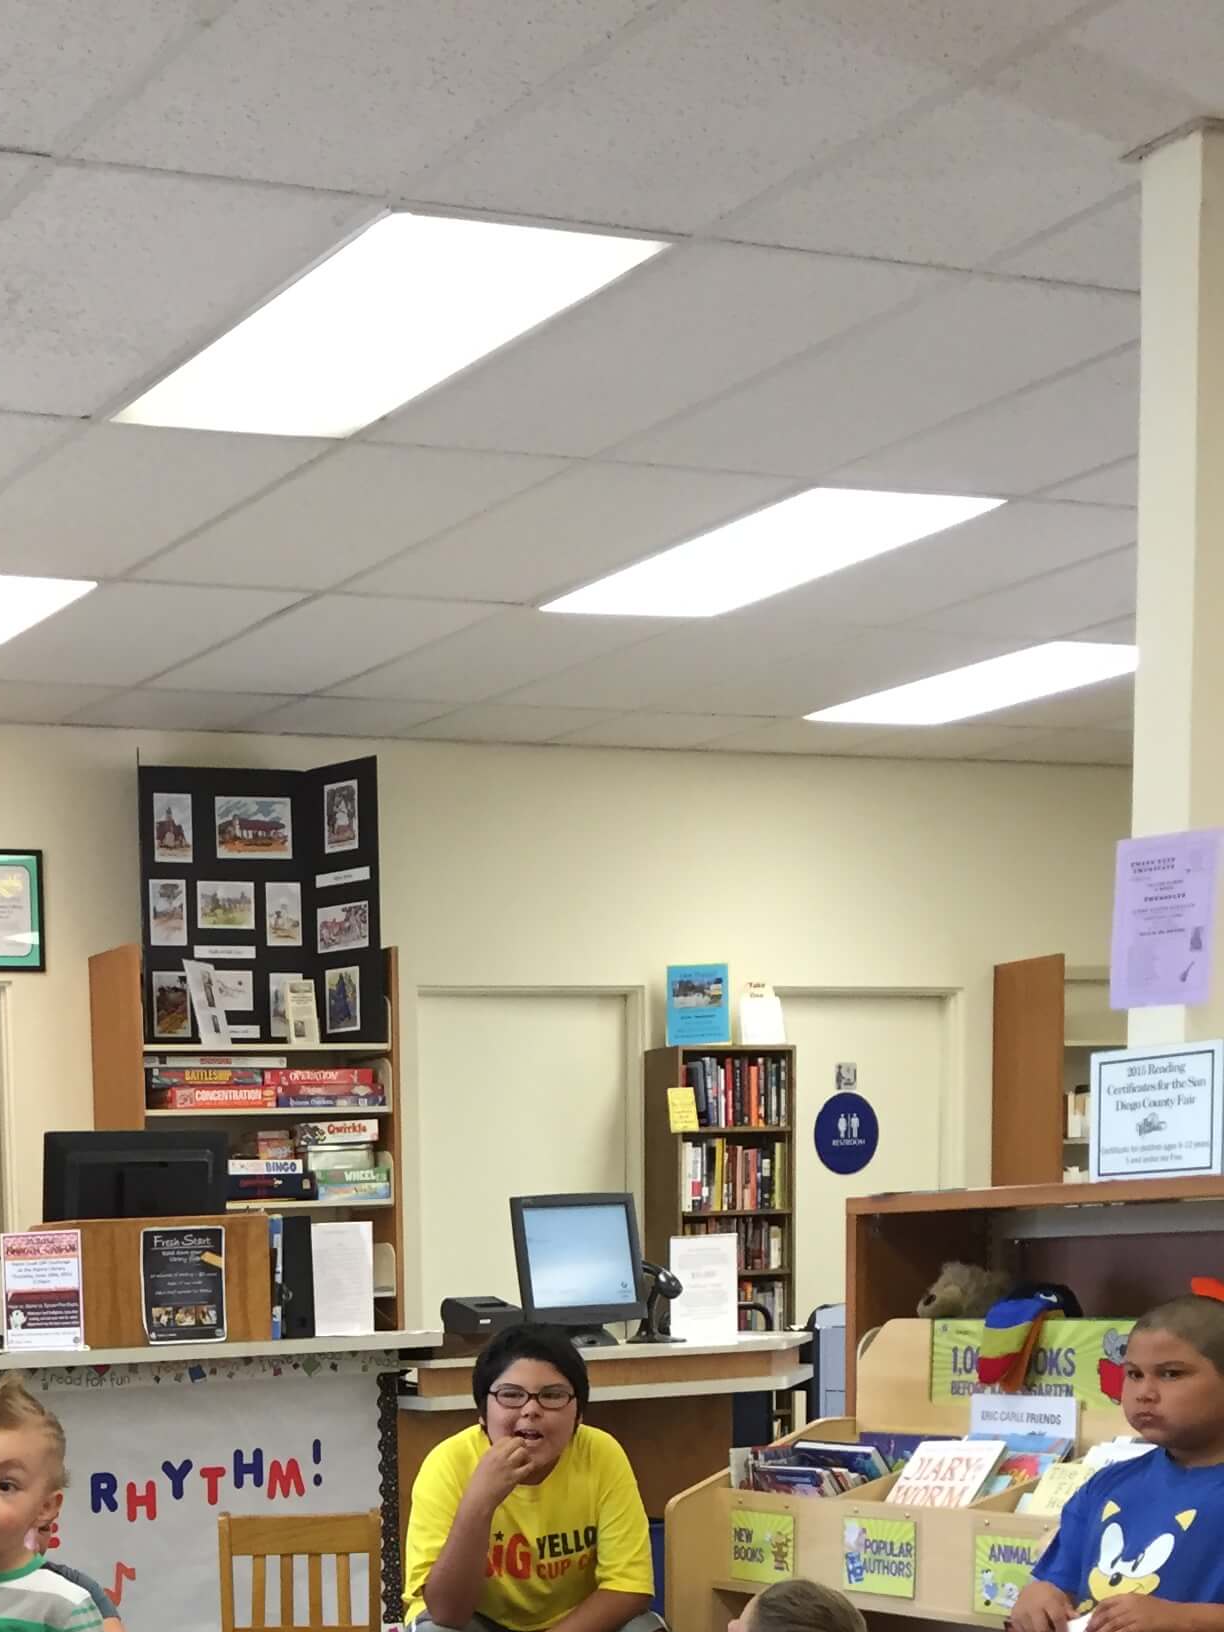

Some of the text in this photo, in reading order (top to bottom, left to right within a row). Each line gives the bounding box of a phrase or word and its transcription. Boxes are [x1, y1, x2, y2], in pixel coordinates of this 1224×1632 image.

[184, 1068, 232, 1081] BATTLESHIP
[289, 1070, 338, 1081] OPERATION
[1148, 1061, 1187, 1074] Reading
[195, 1088, 262, 1101] CONCENTRATION
[1106, 1082, 1157, 1096] Certificates
[1158, 1080, 1170, 1091] for
[1171, 1078, 1186, 1089] the
[1115, 1095, 1197, 1112] Diego County Fair
[831, 1138, 866, 1147] RESTROOM
[265, 1161, 297, 1173] BINGO
[153, 1233, 211, 1248] Fresh Start
[1028, 1347, 1076, 1378] OKS
[49, 1372, 81, 1386] read
[85, 1374, 106, 1388] for
[110, 1374, 131, 1387] fun
[981, 1410, 1062, 1426] ERIC CARLE FRIENDS
[90, 1438, 324, 1522] RHYTHM!
[733, 1527, 754, 1543] NEW
[733, 1546, 765, 1564] BOOKS
[864, 1538, 914, 1559] POPULAR
[988, 1543, 1037, 1566] ANIMAL
[535, 1558, 572, 1581] CUP
[862, 1556, 913, 1578] AUTHORS
